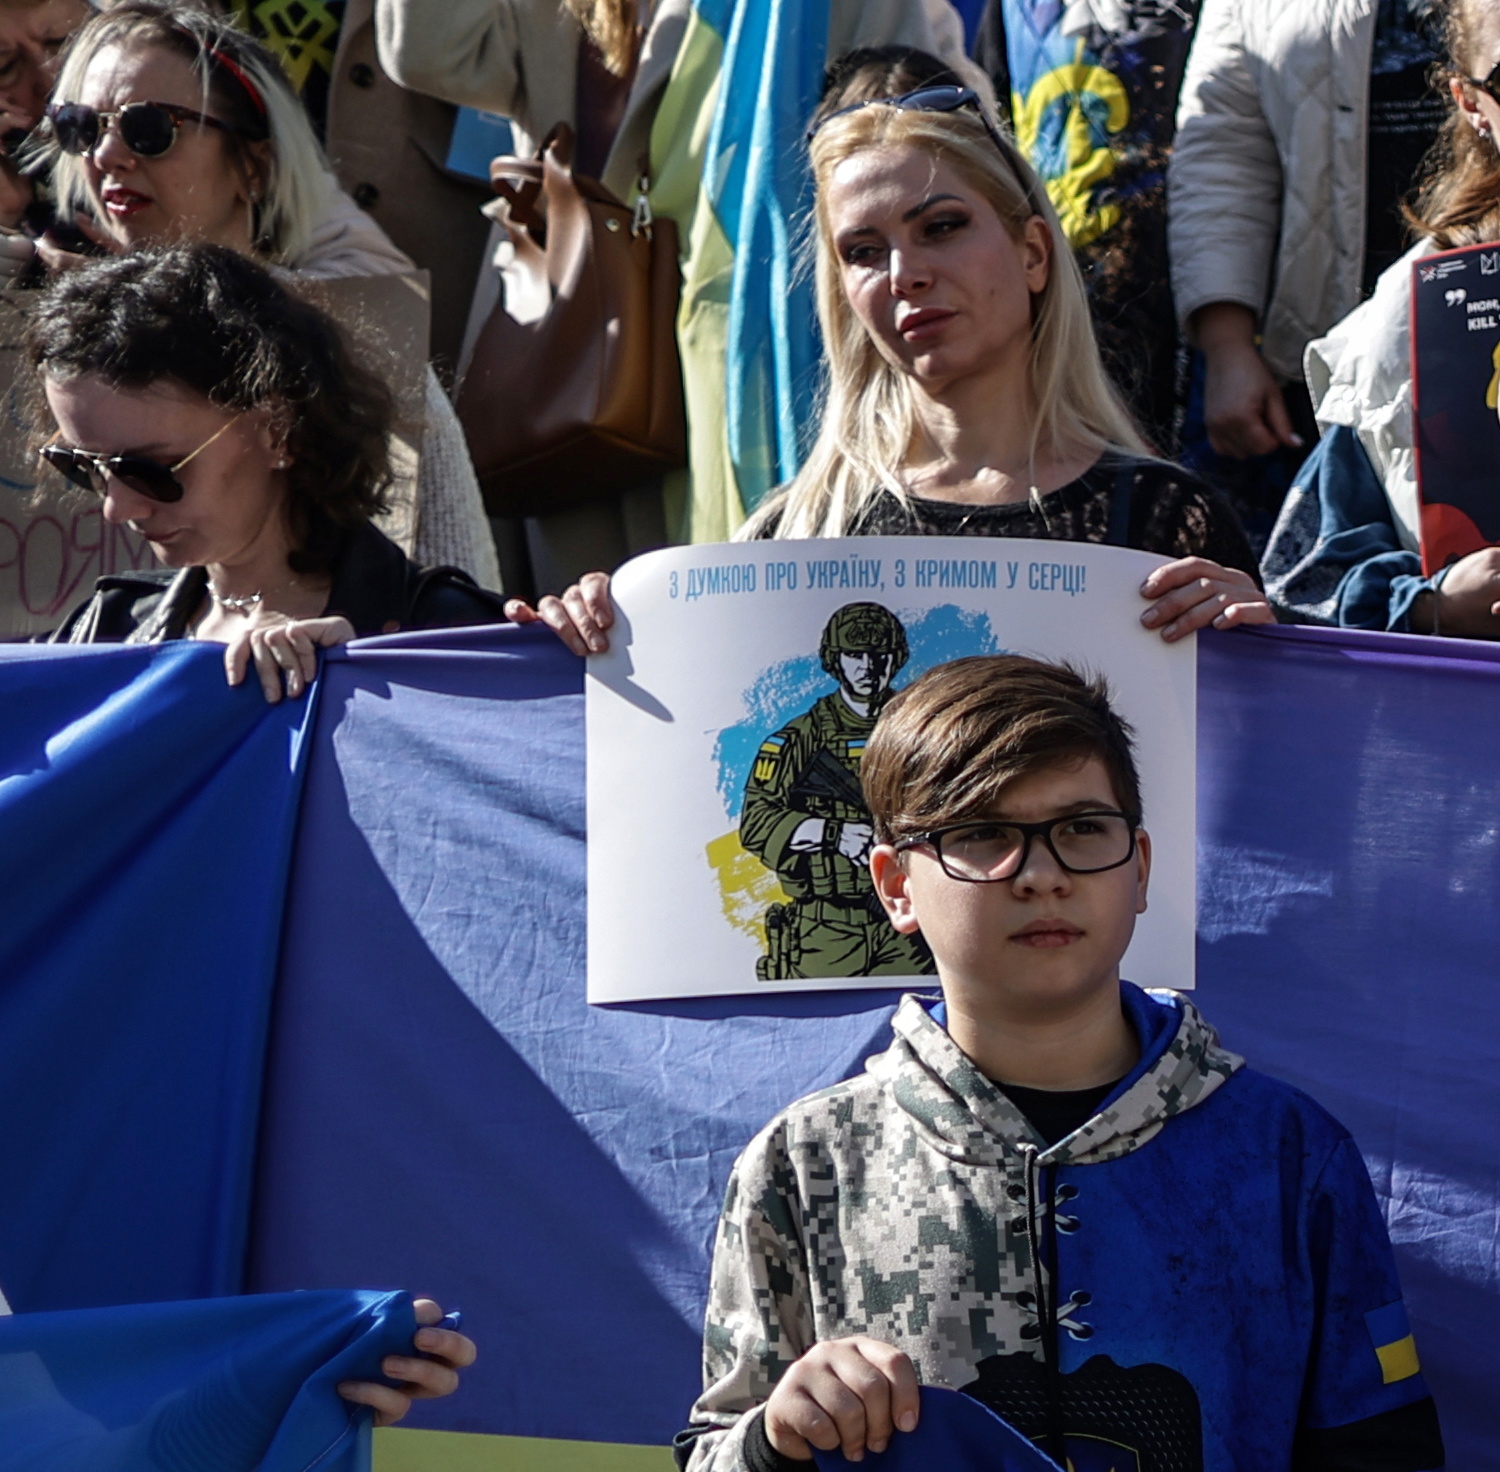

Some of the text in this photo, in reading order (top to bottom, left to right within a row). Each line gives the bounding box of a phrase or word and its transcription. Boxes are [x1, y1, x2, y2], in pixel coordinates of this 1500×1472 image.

[1467, 314, 1499, 332] KILL
[669, 554, 1087, 601] З ДУМКОЮ ПРО УКРАЇНУ, З КРИМОМ У СЕРЦІ!
